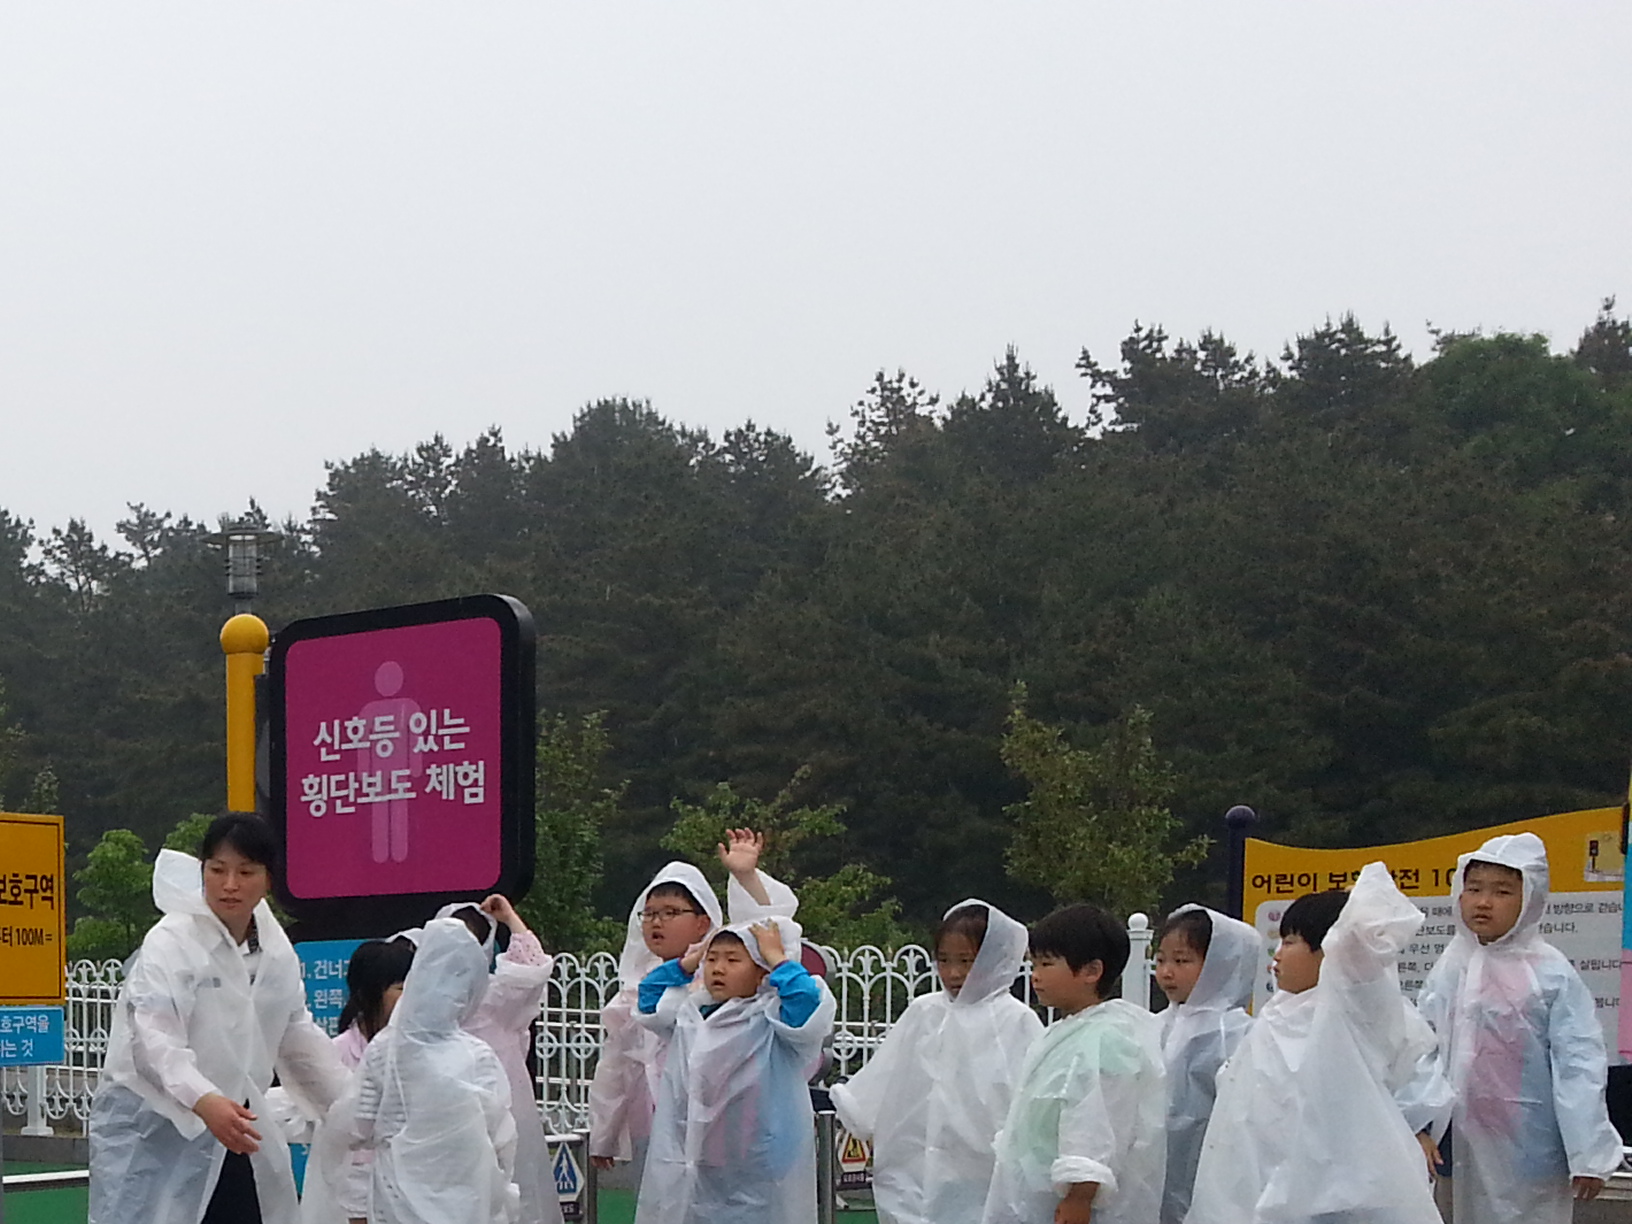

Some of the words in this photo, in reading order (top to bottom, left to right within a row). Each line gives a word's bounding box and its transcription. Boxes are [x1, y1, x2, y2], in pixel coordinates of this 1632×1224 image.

[313, 714, 400, 762] 신호등
[409, 708, 470, 753] 있는
[300, 769, 417, 817] 횡단보도
[424, 760, 485, 804] 체험
[1252, 873, 1318, 894] 어린이
[21, 1039, 34, 1058] 것
